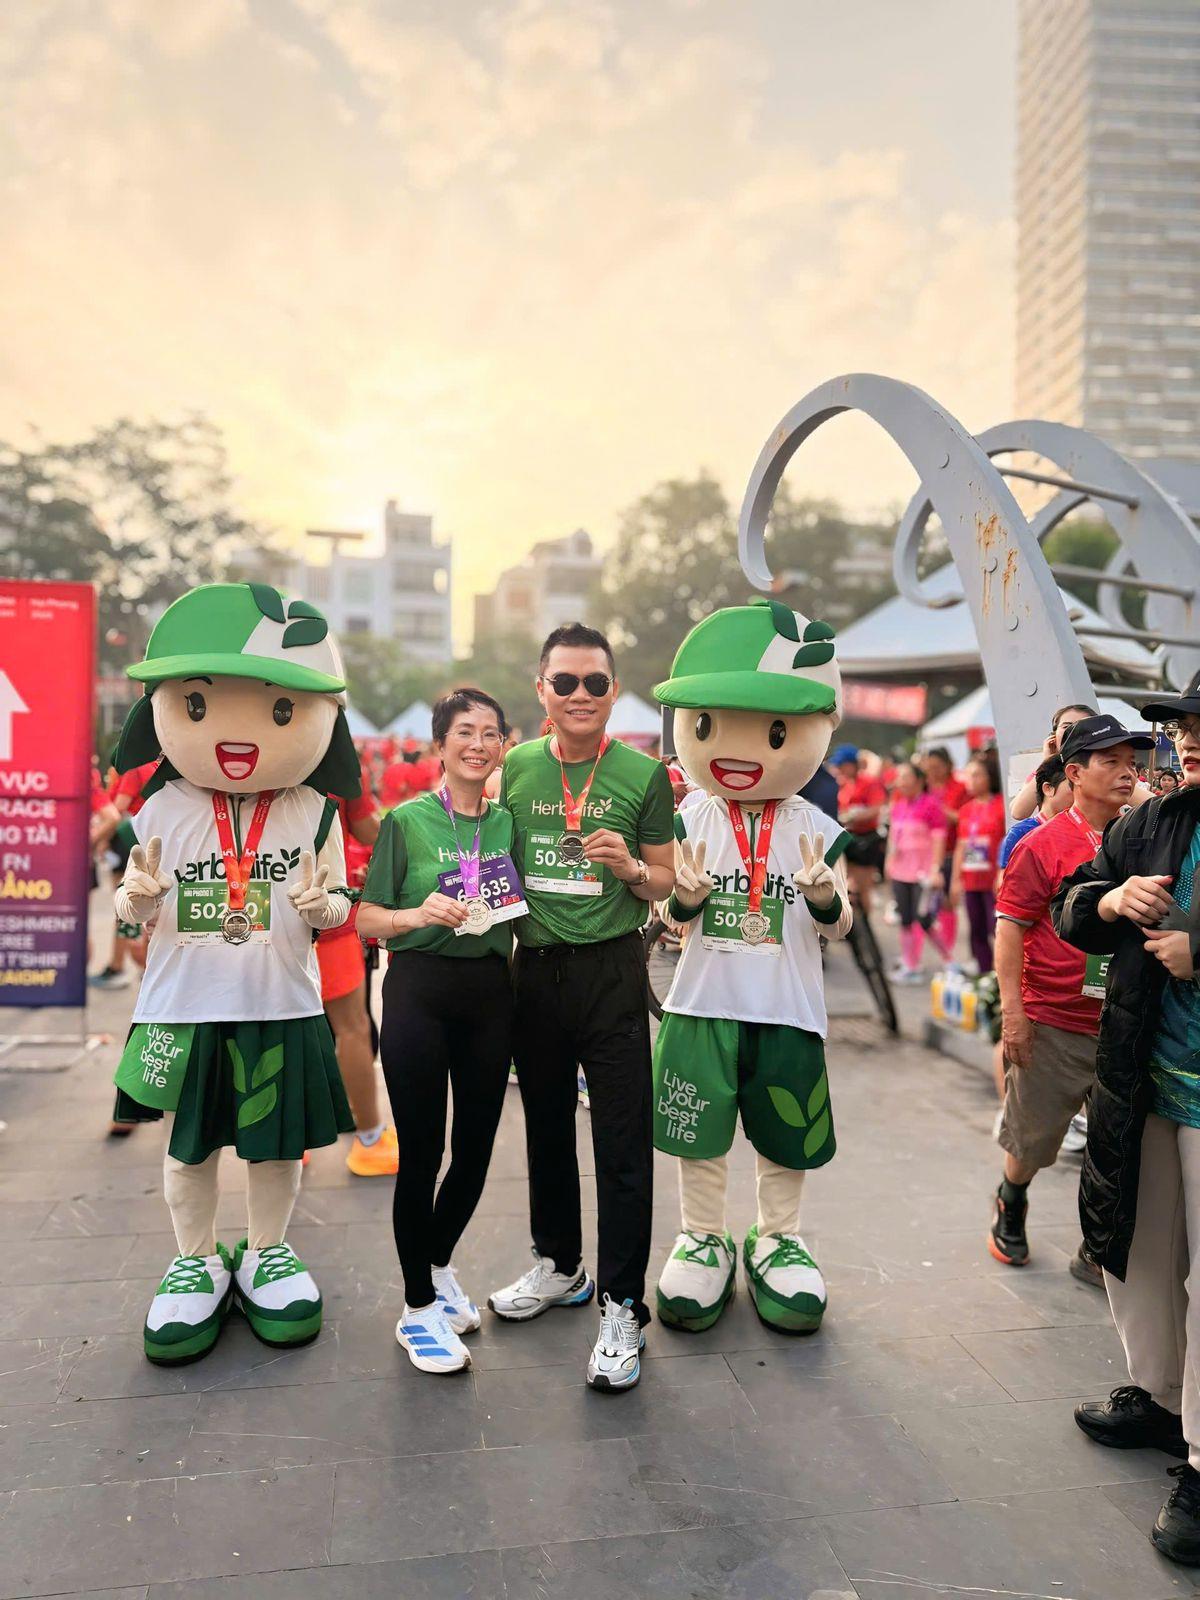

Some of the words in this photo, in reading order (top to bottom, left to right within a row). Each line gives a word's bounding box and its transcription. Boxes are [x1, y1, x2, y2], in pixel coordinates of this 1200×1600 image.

[532, 800, 604, 819] Herbife
[174, 853, 287, 883] erbife
[457, 877, 511, 904] 6635
[190, 902, 258, 920] 5020
[146, 1024, 175, 1044] Live
[141, 1045, 171, 1072] best
[146, 1038, 184, 1058] your
[142, 1066, 167, 1088] life
[664, 1068, 698, 1096] Live
[658, 1096, 699, 1127] best
[666, 1087, 710, 1112] your
[666, 1120, 697, 1144] life
